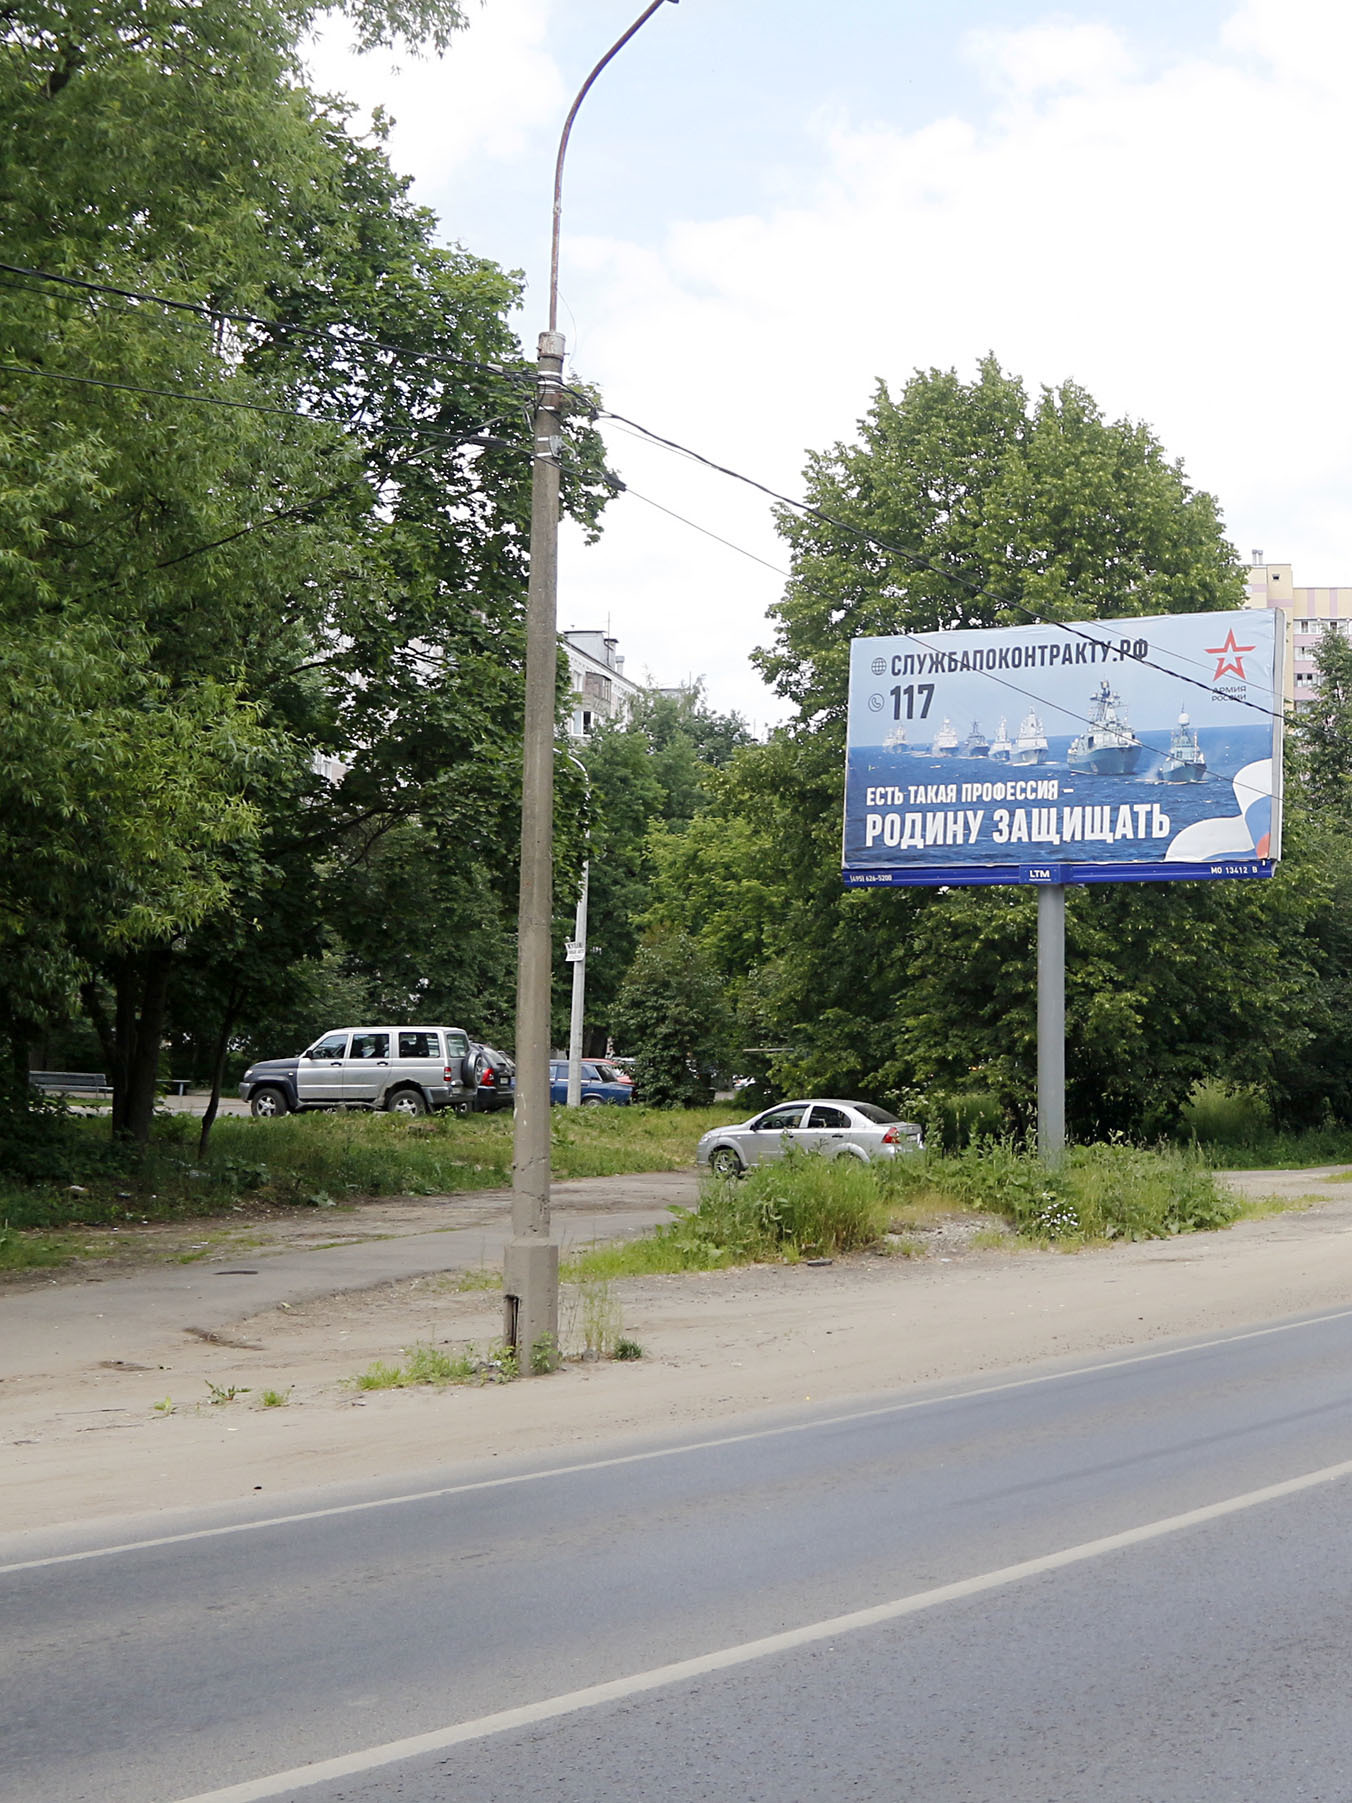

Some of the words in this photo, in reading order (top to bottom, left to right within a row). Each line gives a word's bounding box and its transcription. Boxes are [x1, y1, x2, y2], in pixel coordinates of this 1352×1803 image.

[890, 638, 1149, 677] СЛУЖБАПОКОНТРАКТУ.РФ
[889, 683, 935, 721] 117
[1211, 694, 1247, 702] РОСИИ
[866, 786, 904, 806] ЕСТЬ
[908, 784, 957, 804] ТАКАЯ
[961, 779, 1059, 802] ПРОФЕССИЯ
[865, 809, 985, 850] РОДИНУ
[992, 803, 1171, 846] ЗАЩИЩАТЬ
[1029, 869, 1050, 878] LTM
[1225, 866, 1248, 874] 13412
